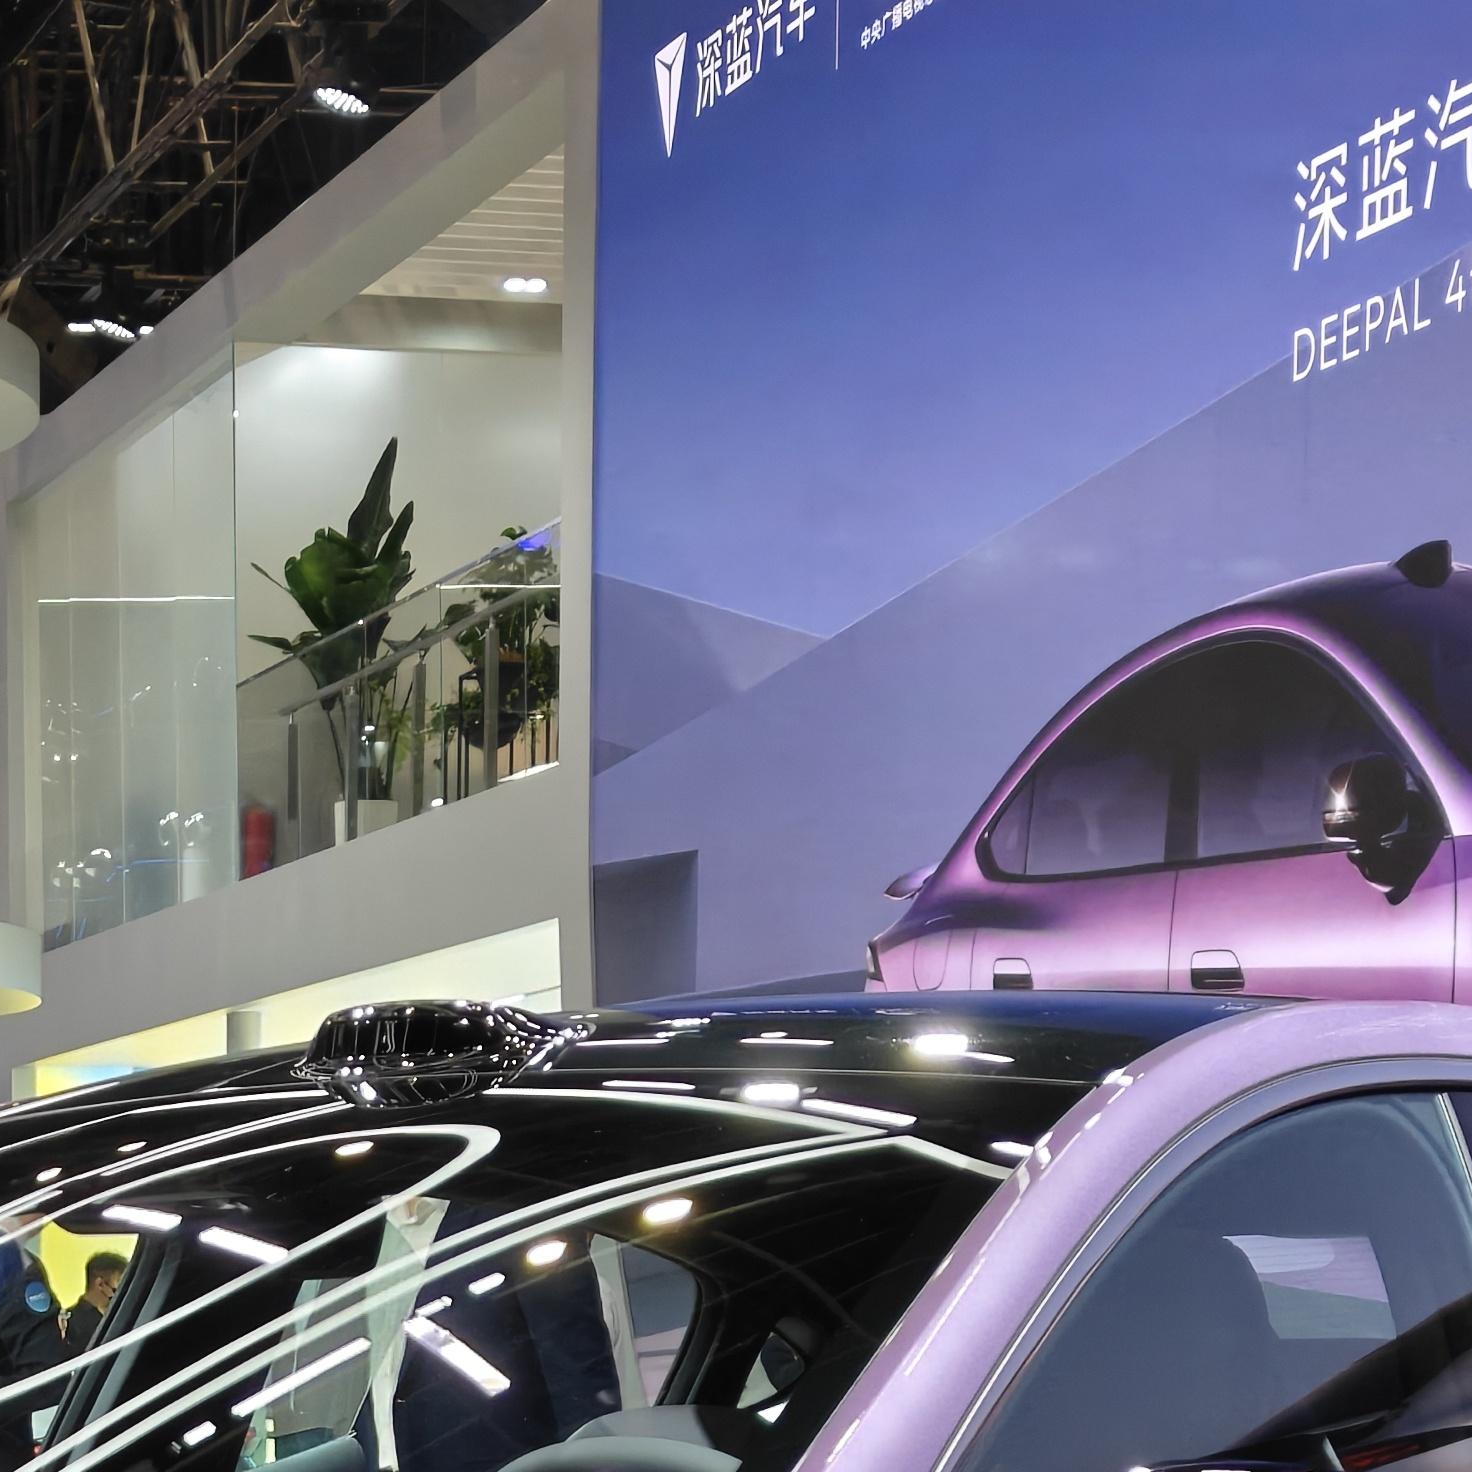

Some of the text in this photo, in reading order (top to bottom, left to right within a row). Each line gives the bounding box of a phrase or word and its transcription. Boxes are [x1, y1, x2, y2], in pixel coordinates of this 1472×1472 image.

[695, 0, 816, 117] 深蓝汽车
[859, 0, 936, 50] 中央广播电视
[1292, 278, 1431, 382] DEEPAL
